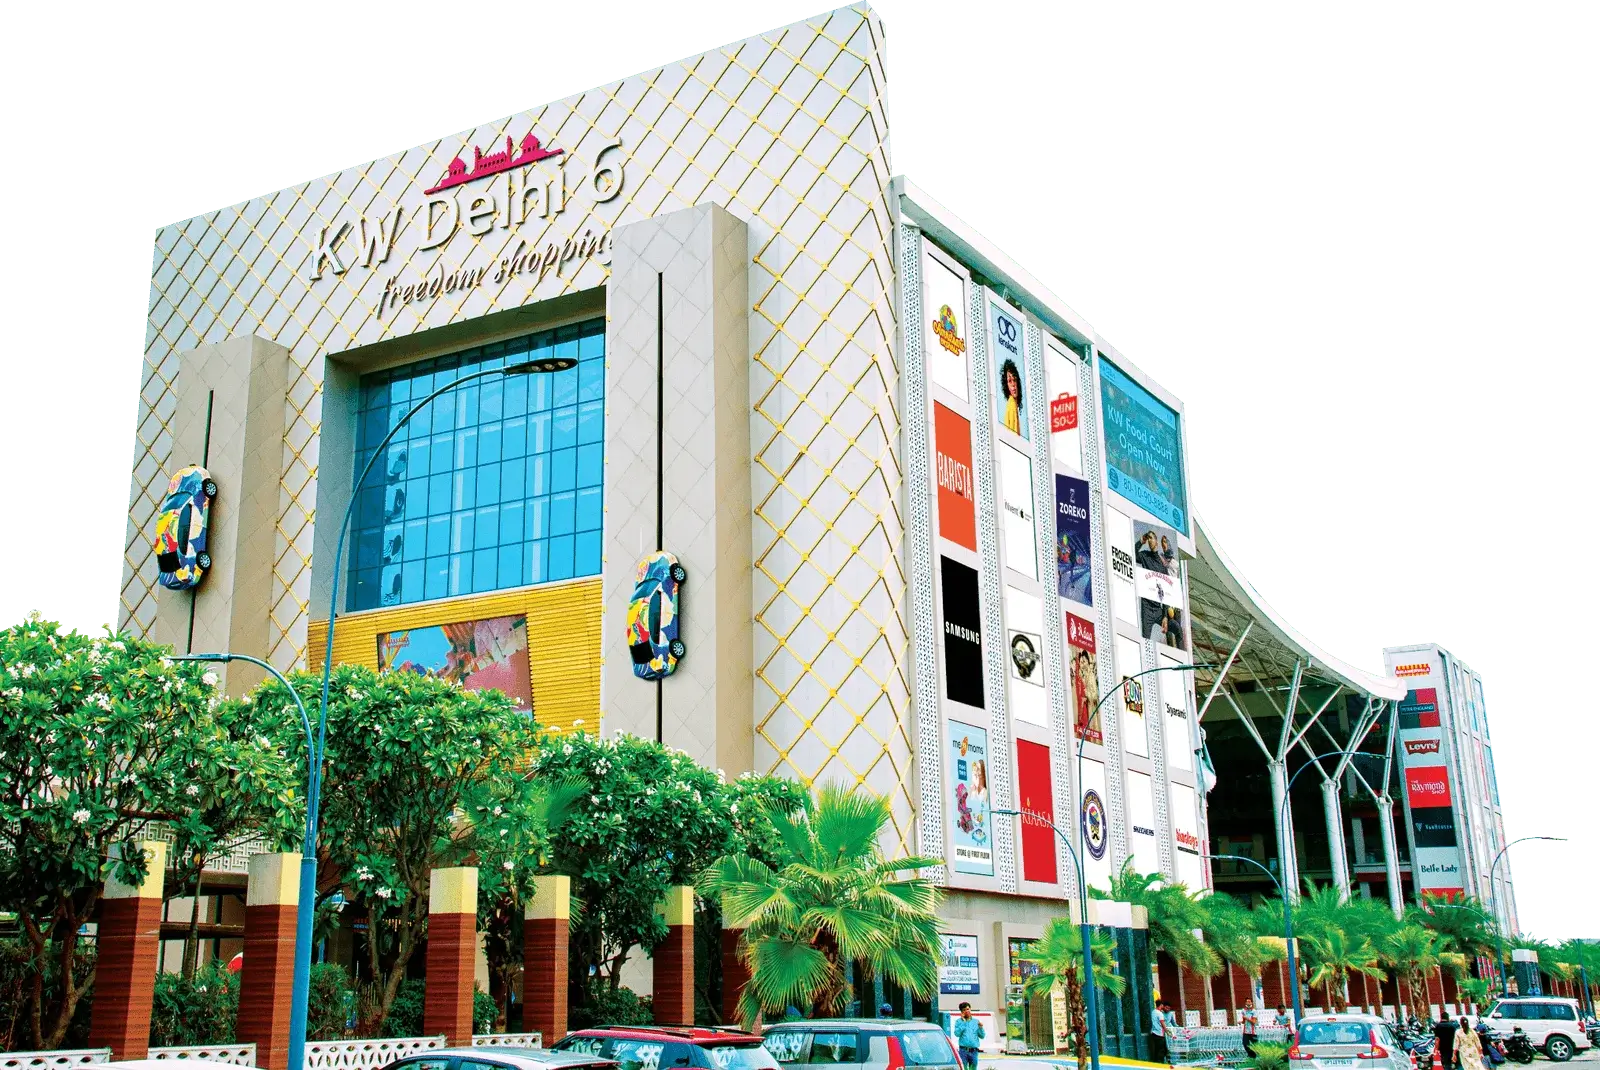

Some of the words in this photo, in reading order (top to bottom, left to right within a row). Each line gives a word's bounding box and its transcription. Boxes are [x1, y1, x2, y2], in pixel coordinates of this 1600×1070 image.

[308, 203, 404, 281] KW
[418, 154, 568, 252] Delhi
[592, 136, 625, 204] 6
[376, 262, 484, 320] freedom
[1119, 433, 1144, 461] Open
[1145, 450, 1165, 475] Now
[1126, 417, 1147, 444] Food
[1149, 435, 1172, 461] Court
[937, 450, 973, 502] BARISTA
[1060, 502, 1087, 520] ZOREKO
[1111, 545, 1133, 567] FROZEN
[1112, 558, 1134, 579] BOTTLE
[945, 621, 980, 645] SAMSUNG
[1441, 864, 1458, 873] Lady
